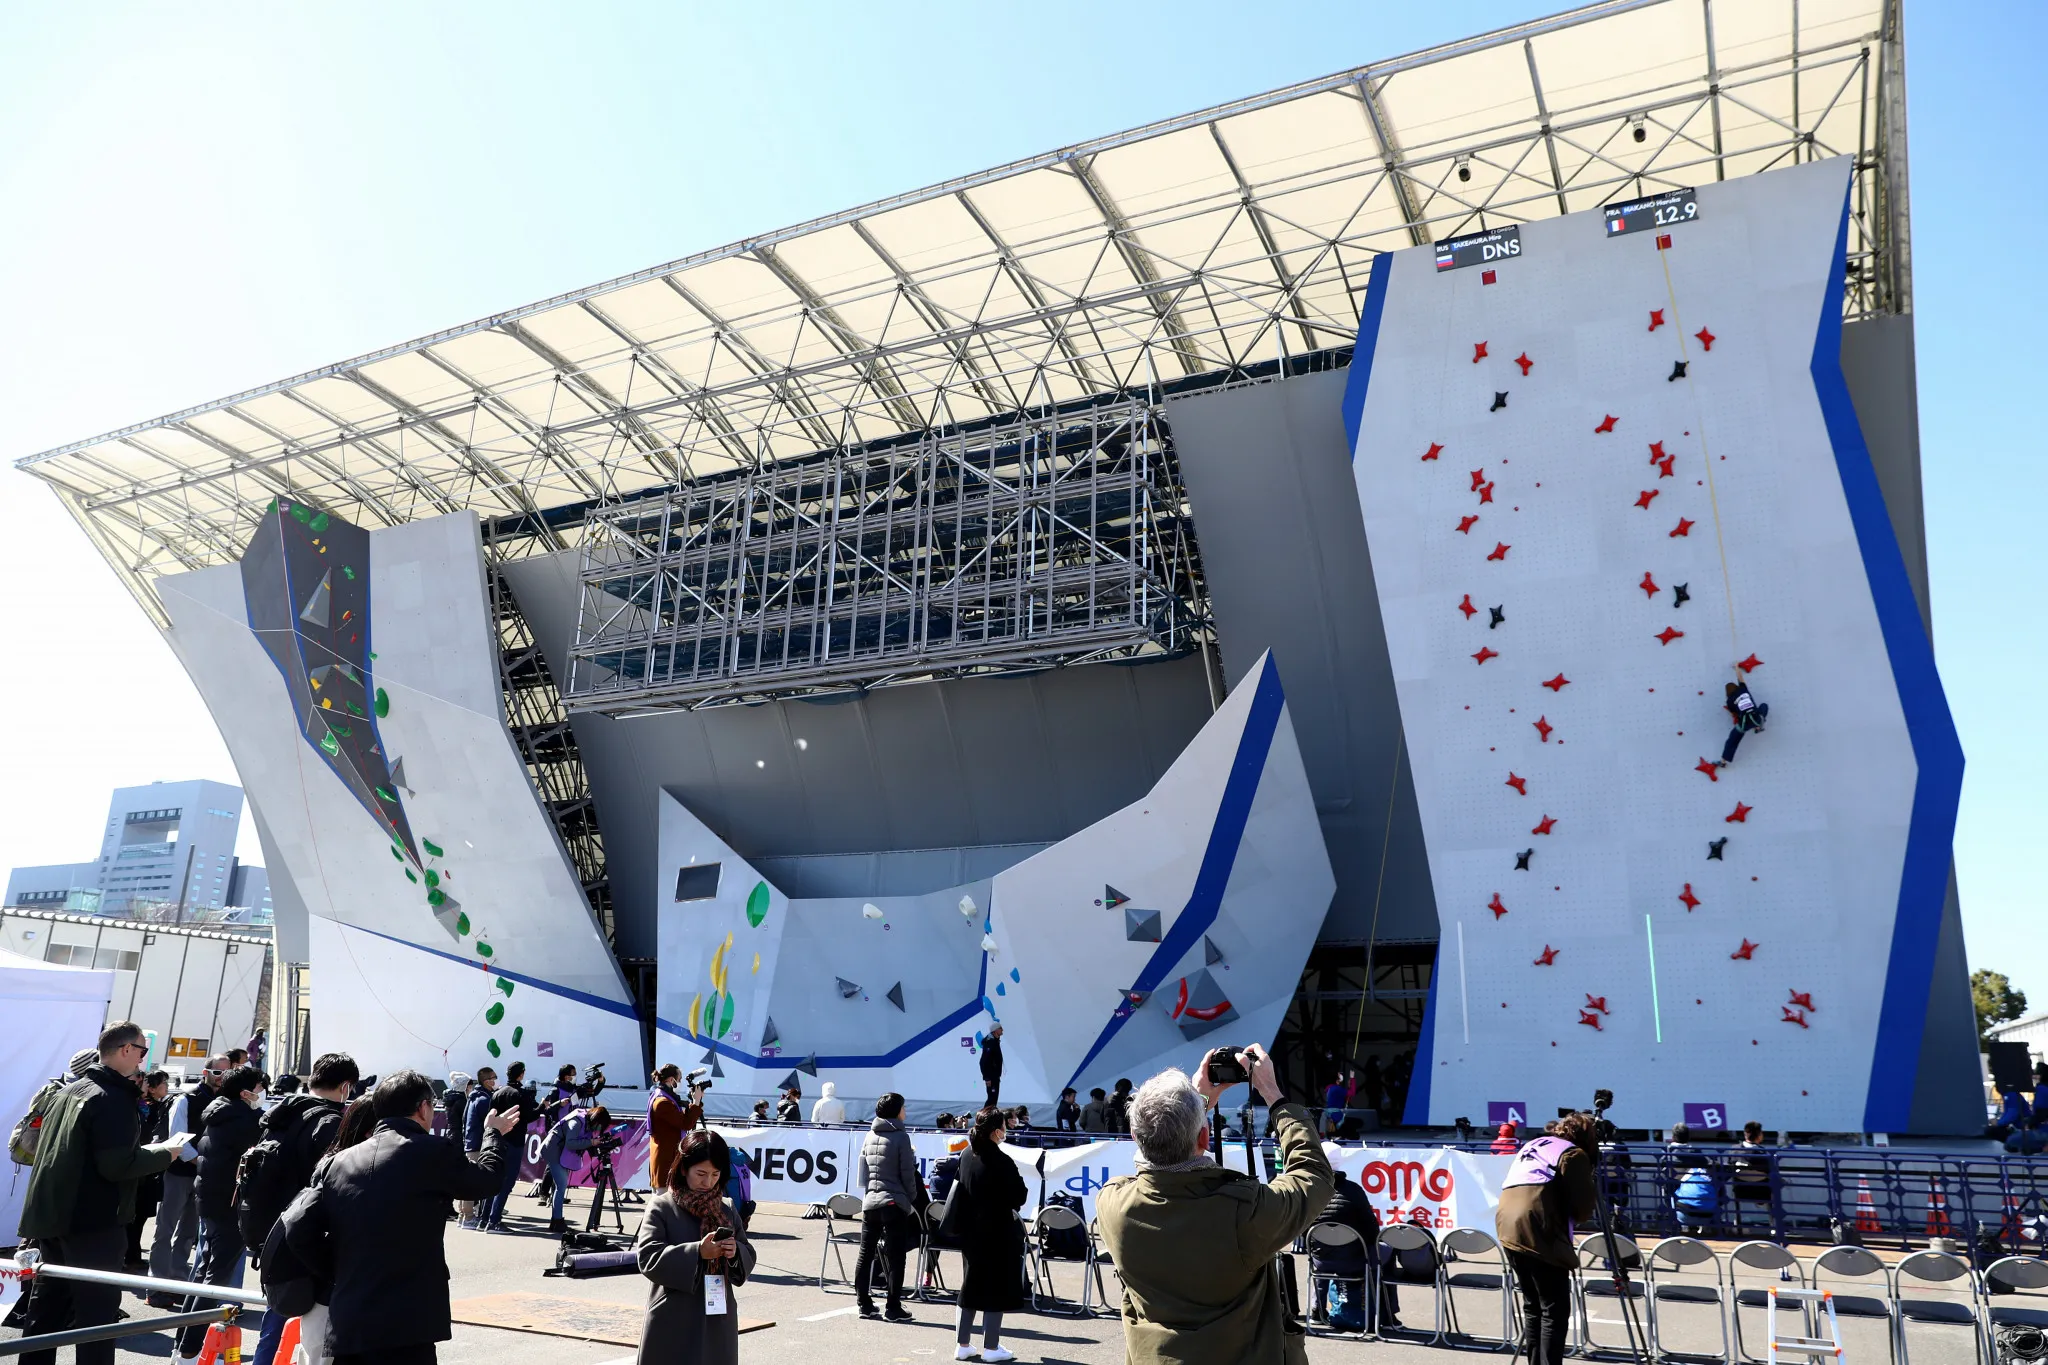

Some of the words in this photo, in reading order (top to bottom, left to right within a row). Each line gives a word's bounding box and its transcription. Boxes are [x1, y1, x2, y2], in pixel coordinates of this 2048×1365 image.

[1655, 202, 1697, 225] 12.9
[1436, 245, 1449, 253] RUS
[1452, 236, 1489, 249] TAKEMURA
[1488, 234, 1502, 242] Hiro
[1482, 239, 1520, 260] DNS
[1507, 1107, 1525, 1124] A
[1701, 1108, 1723, 1129] B
